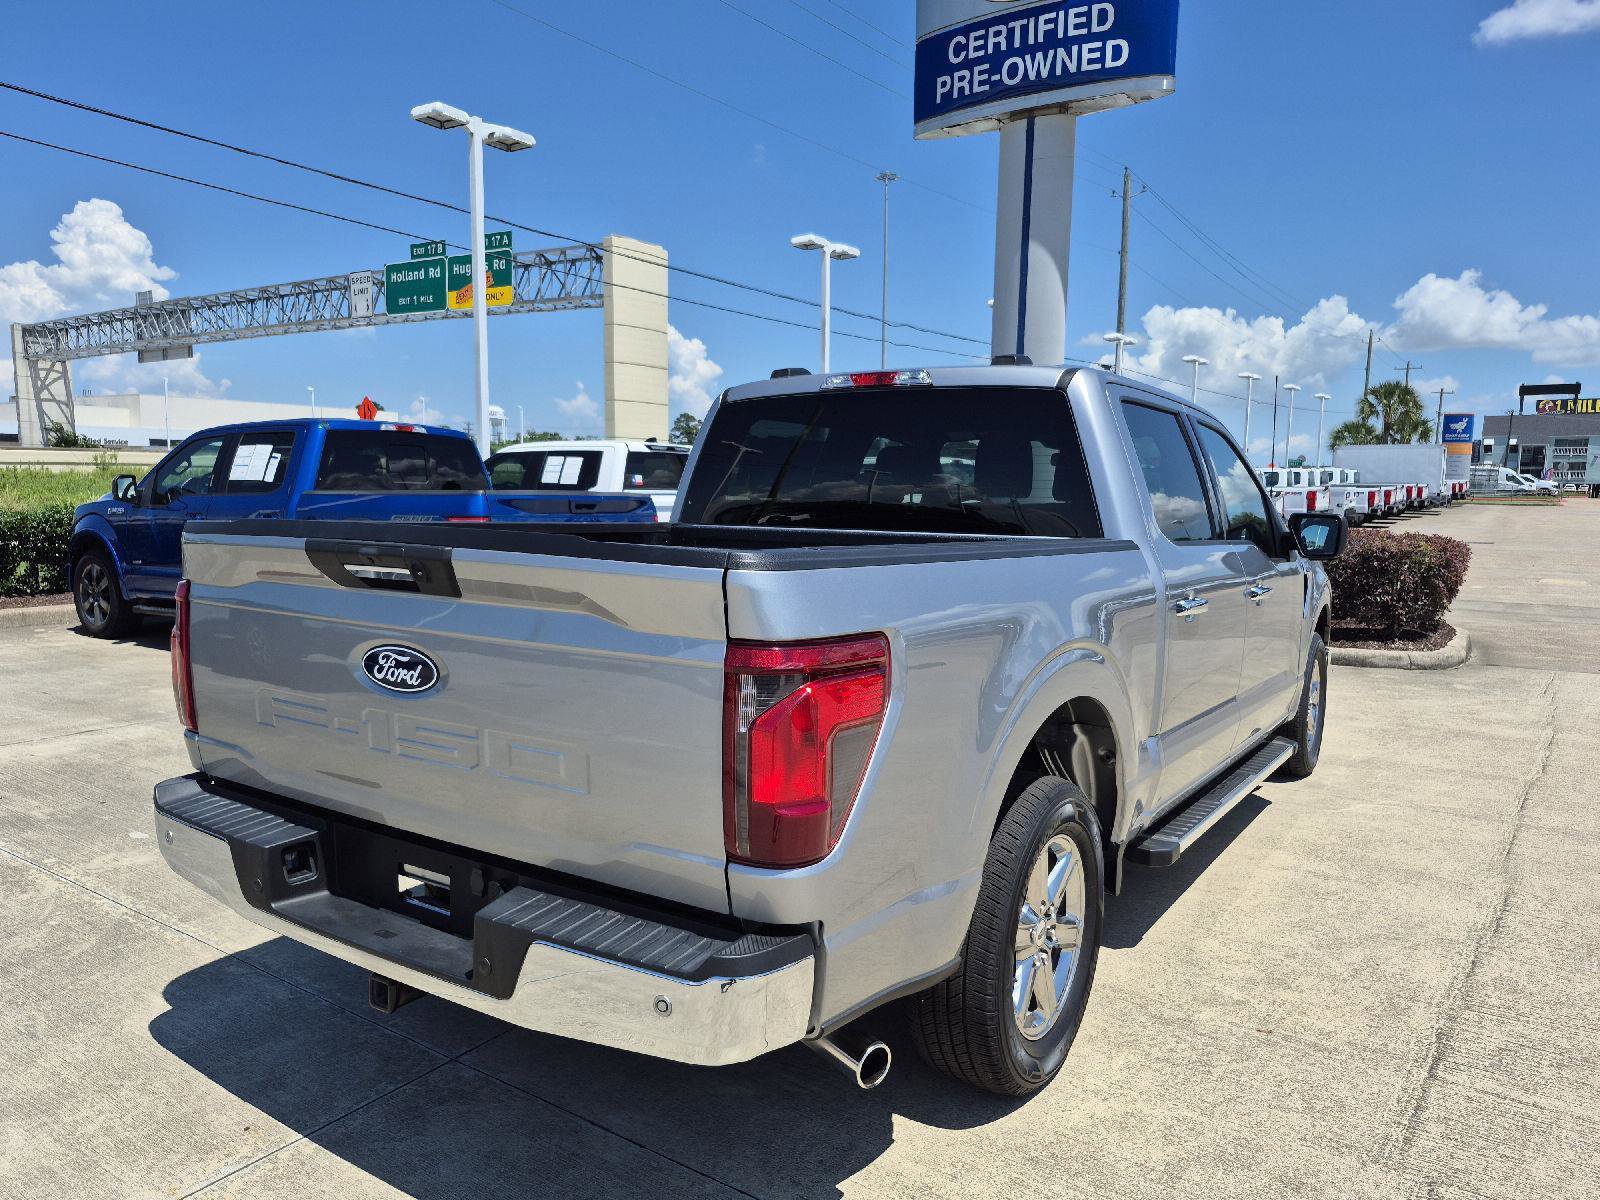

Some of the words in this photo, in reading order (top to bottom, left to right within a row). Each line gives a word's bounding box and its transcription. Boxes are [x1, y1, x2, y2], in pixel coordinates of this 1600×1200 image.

[948, 2, 1116, 65] CERTIFIED
[936, 38, 1130, 104] PRE-OWNED
[491, 235, 501, 247] 17
[502, 234, 509, 246] A
[413, 247, 425, 256] EXIT
[427, 244, 436, 255] 17
[437, 243, 443, 254] B
[493, 259, 506, 270] Rd
[351, 275, 371, 285] SPEED
[391, 268, 425, 283] Holland
[429, 265, 441, 279] Rd
[353, 287, 369, 296] LIMIT
[485, 290, 505, 301] ONLY
[399, 297, 410, 306] EXIT
[413, 295, 418, 305] 1
[420, 295, 433, 303] MILE
[373, 651, 423, 686] Ford
[256, 687, 591, 795] F-150
